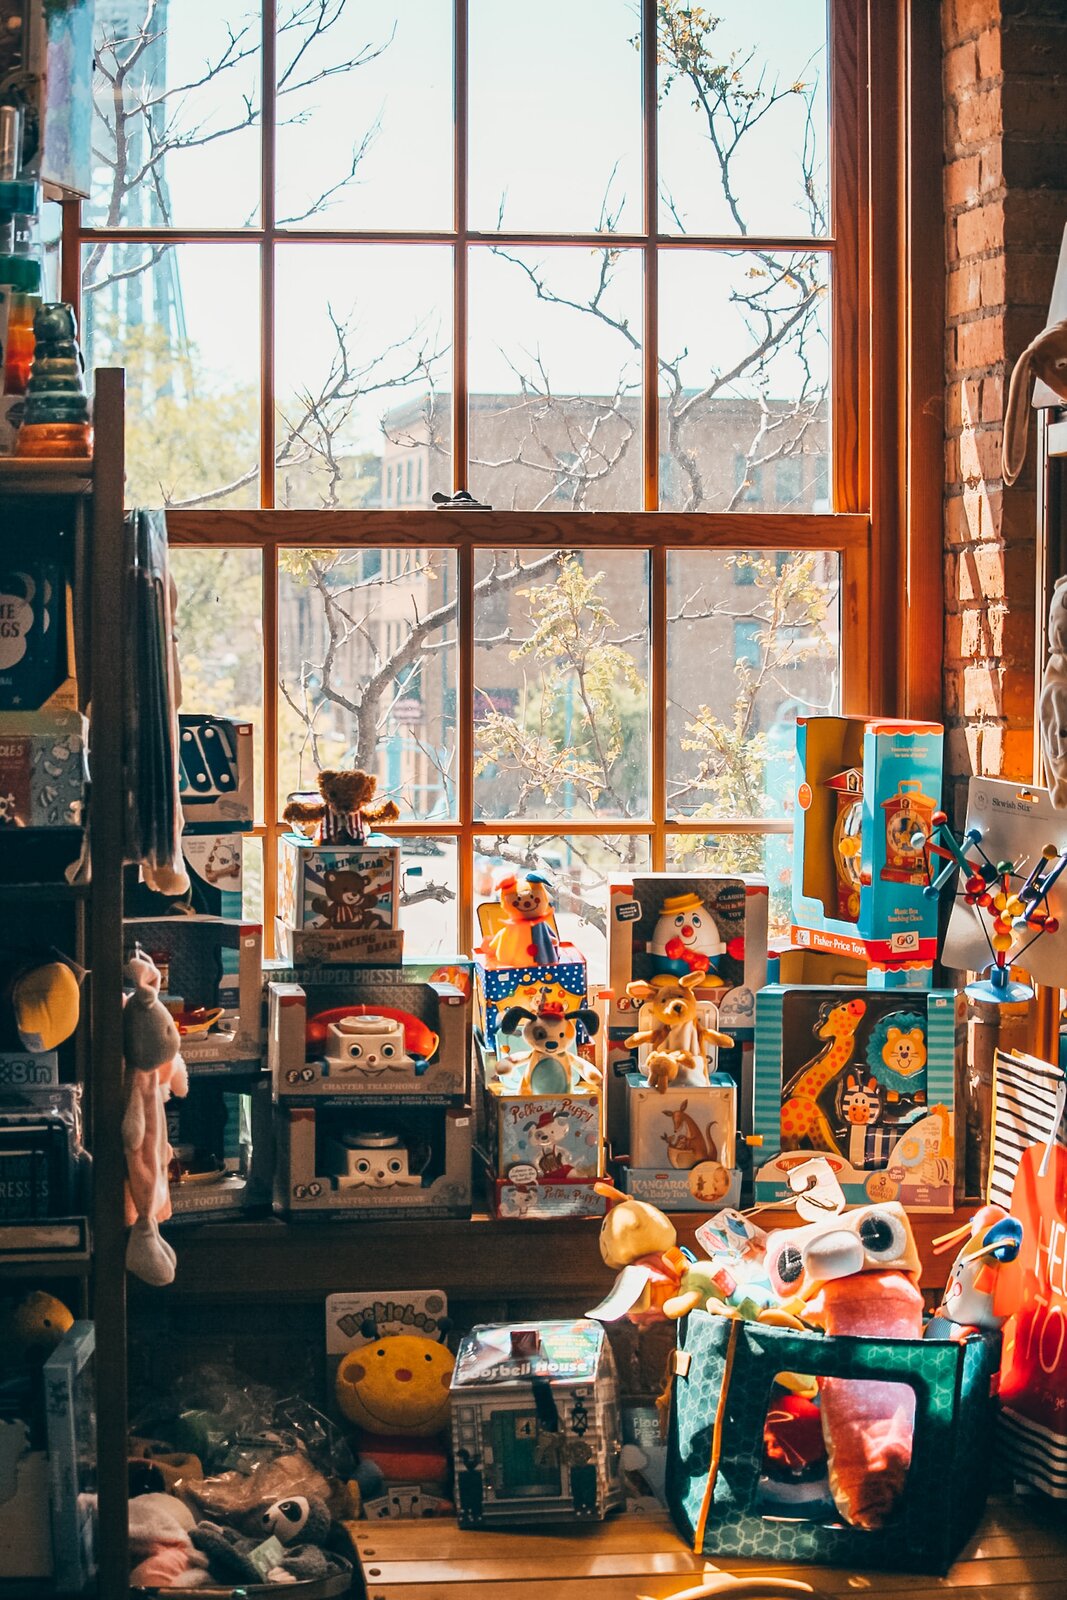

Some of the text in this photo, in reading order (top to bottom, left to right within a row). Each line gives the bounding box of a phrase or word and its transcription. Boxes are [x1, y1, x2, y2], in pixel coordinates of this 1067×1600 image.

[992, 798, 1016, 810] Skwish
[315, 856, 384, 873] DANCING BEAR
[813, 935, 851, 951] Fisher-Price
[851, 942, 867, 955] Toys
[262, 970, 299, 985] PETER
[354, 969, 394, 984] PRESS
[182, 1048, 220, 1059] OOTER
[322, 1083, 421, 1091] CHATTER TELEPHONE
[510, 1098, 594, 1125] Polka Puppy
[631, 1180, 692, 1194] KANGAROO
[880, 1176, 887, 1186] 3
[543, 1185, 570, 1200] Polka
[650, 1189, 671, 1199] Baby
[672, 1189, 688, 1198] Too
[535, 1360, 588, 1373] House
[520, 1420, 531, 1435] 4
